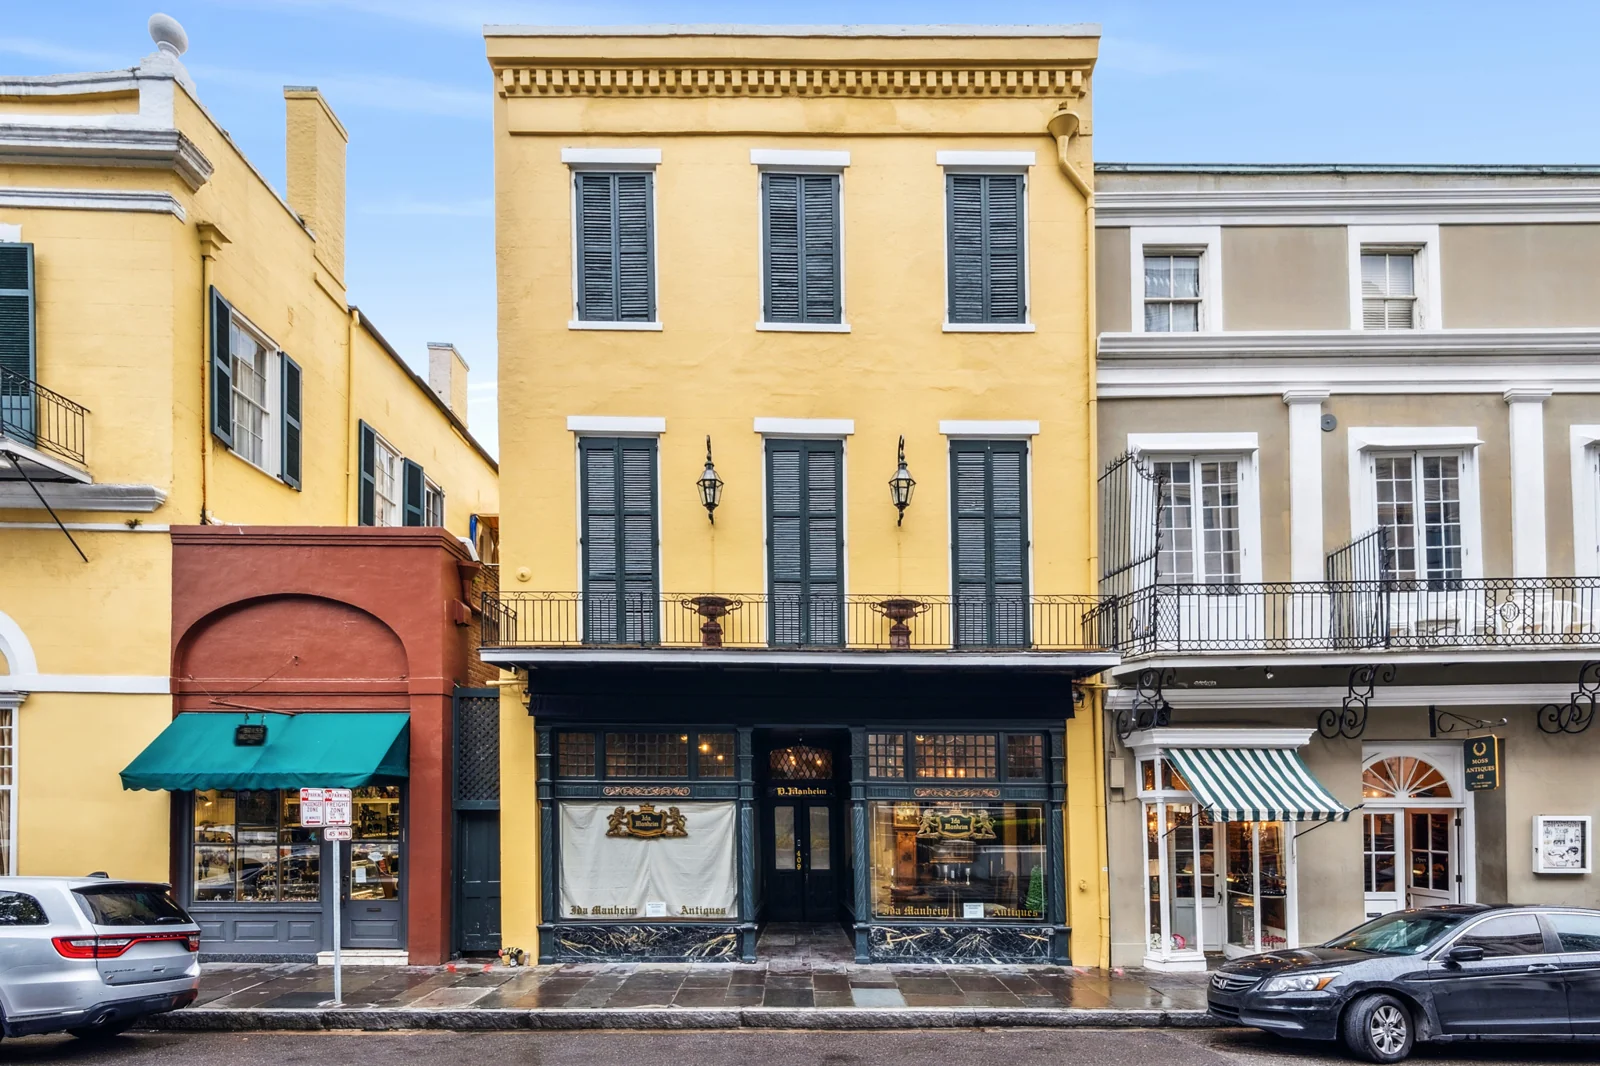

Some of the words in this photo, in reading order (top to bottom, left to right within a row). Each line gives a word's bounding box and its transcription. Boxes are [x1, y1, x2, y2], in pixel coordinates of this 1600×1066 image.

[1466, 765, 1495, 773] ANTIQUES
[569, 905, 588, 915] Ida
[591, 905, 638, 917] Manheim
[680, 905, 726, 917] Antiques
[882, 906, 901, 916] Ida
[903, 905, 950, 918] Manheim
[992, 906, 1039, 918] Antiques
